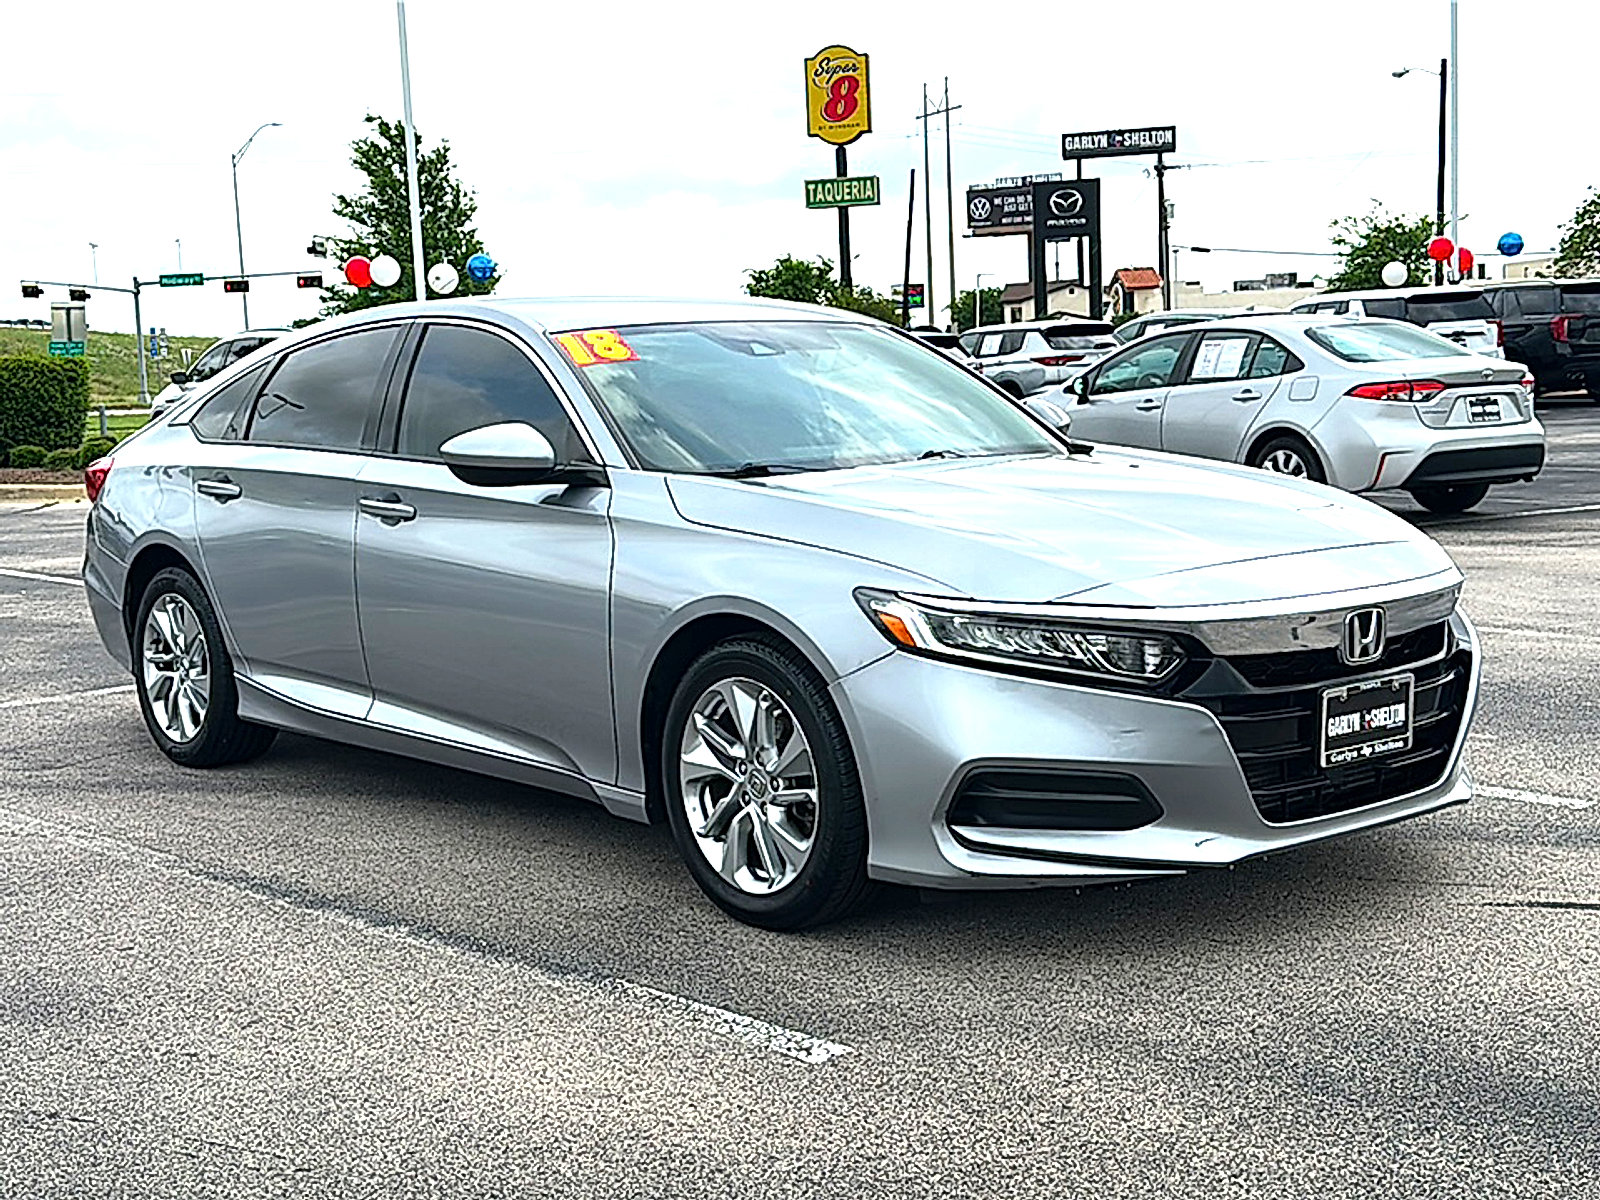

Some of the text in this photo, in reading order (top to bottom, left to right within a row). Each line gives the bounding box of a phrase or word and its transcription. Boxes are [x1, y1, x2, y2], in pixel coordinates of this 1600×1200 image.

[814, 56, 860, 85] Super
[823, 75, 860, 121] 8
[1064, 134, 1108, 150] GARLYN
[1123, 129, 1173, 146] SHELTON
[807, 181, 873, 203] TAQUERIA
[556, 329, 632, 364] 18
[1327, 702, 1406, 738] GARLYN SHELTON
[1329, 740, 1405, 763] Garlyn Shelton
